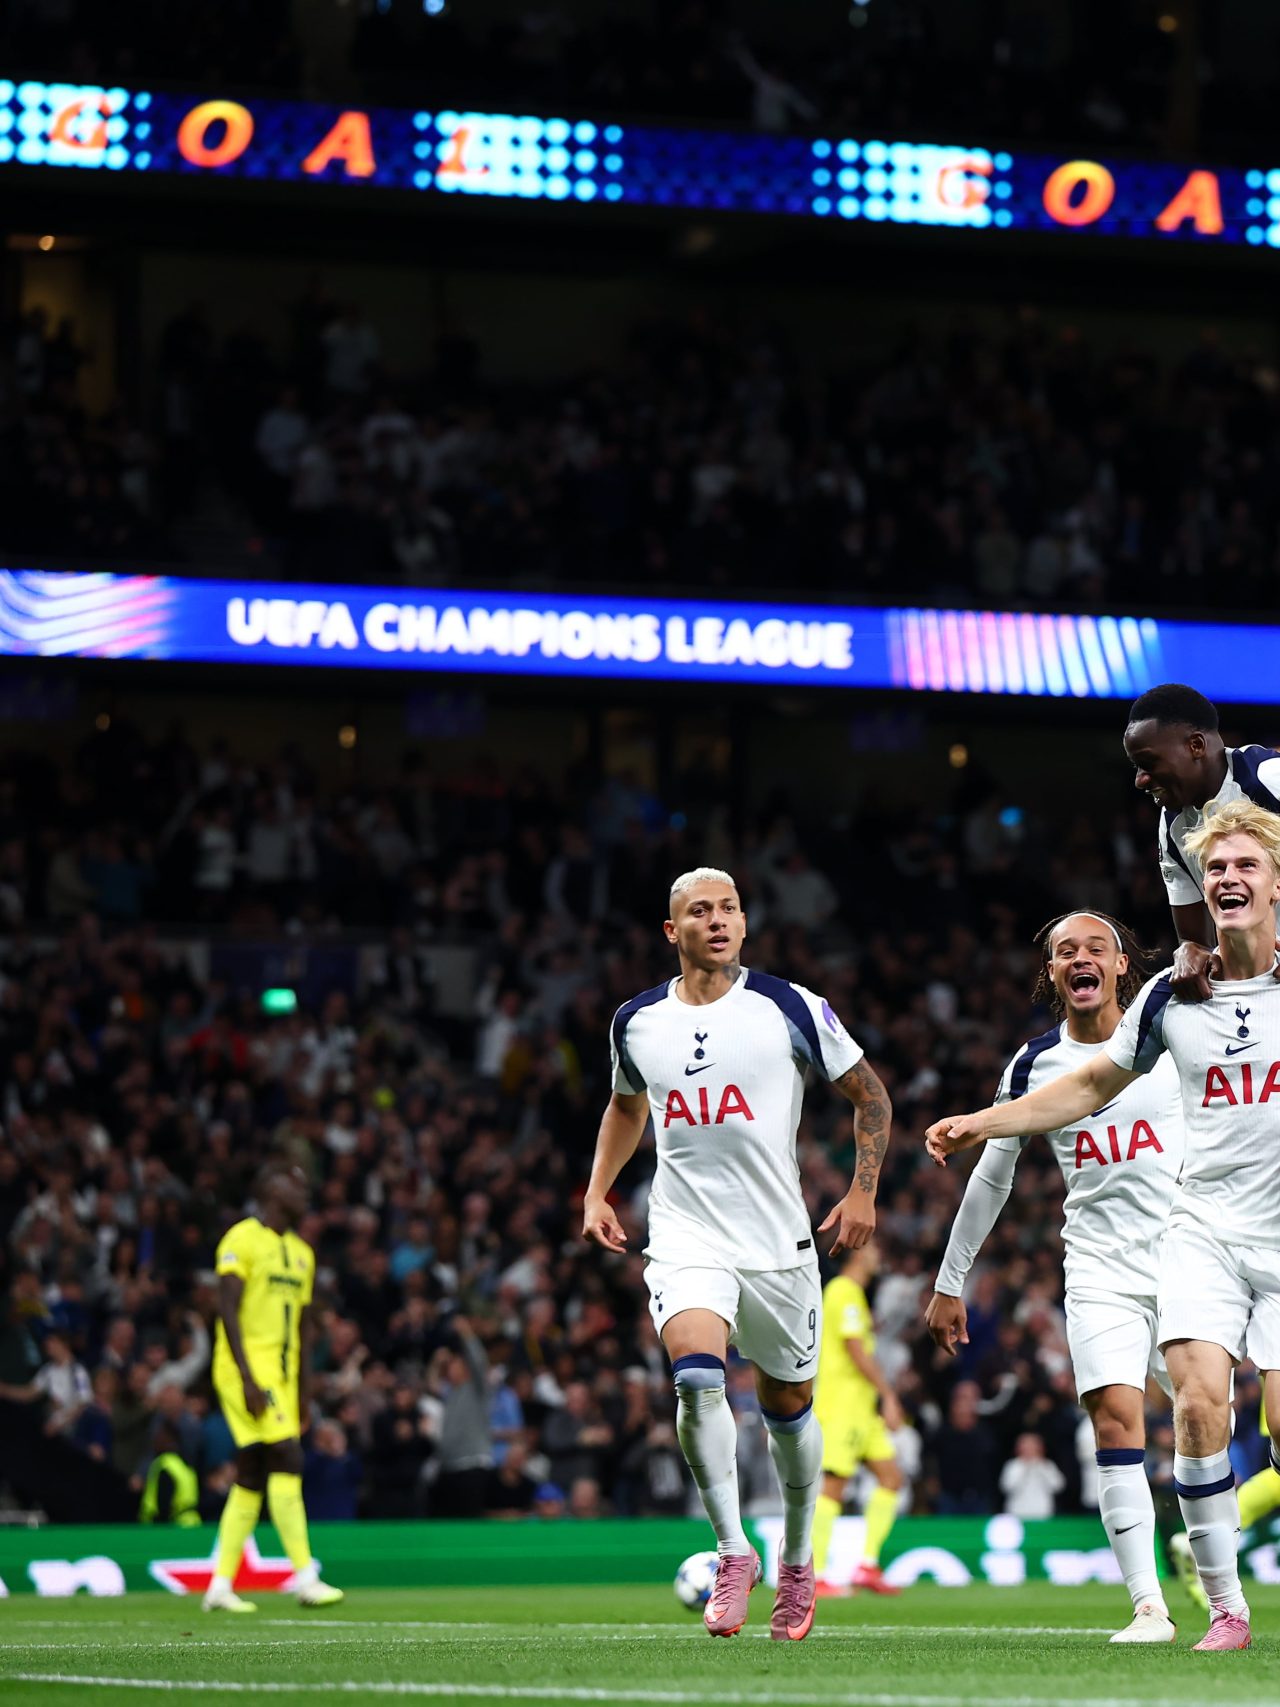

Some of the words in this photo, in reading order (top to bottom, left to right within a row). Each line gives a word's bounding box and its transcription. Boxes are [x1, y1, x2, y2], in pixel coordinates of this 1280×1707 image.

[227, 598, 358, 650] UEFA
[363, 603, 661, 663] CHAMPIONS
[665, 617, 854, 669] LEAGUE
[664, 1084, 754, 1128] AIA
[1075, 1119, 1164, 1169] AIA
[807, 1309, 816, 1351] 9
